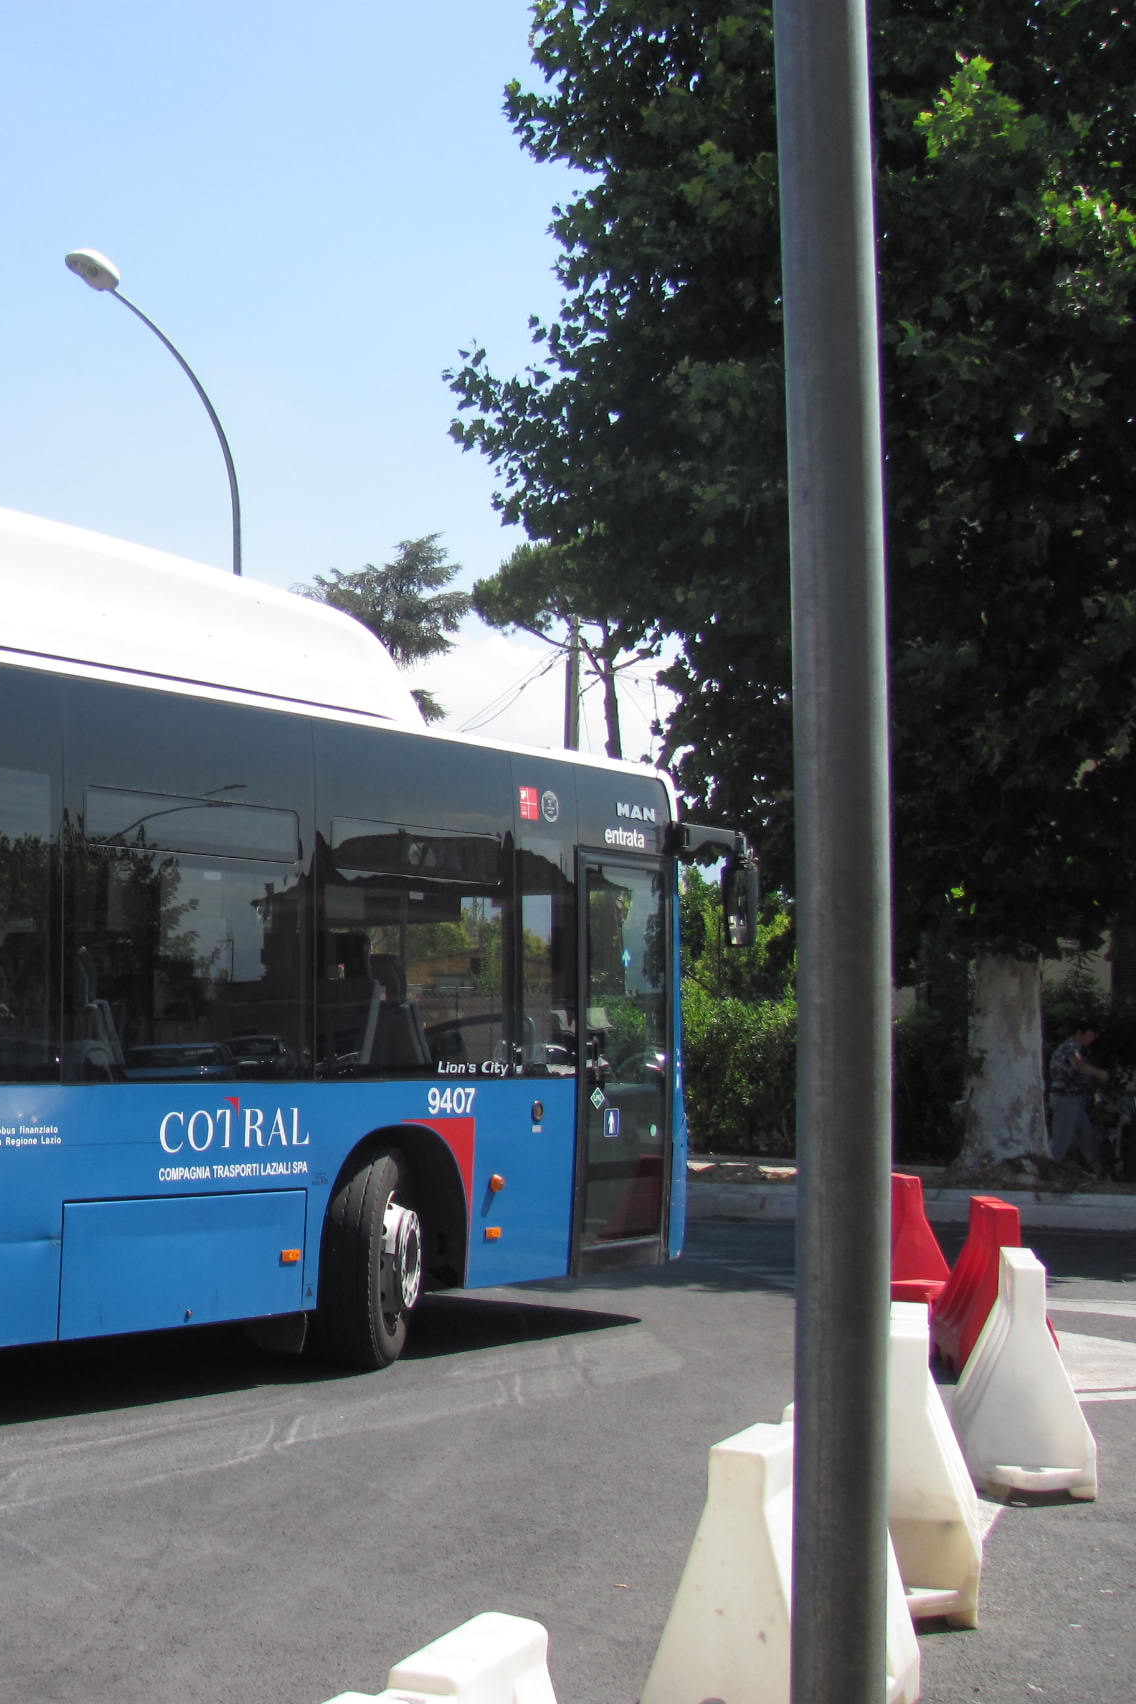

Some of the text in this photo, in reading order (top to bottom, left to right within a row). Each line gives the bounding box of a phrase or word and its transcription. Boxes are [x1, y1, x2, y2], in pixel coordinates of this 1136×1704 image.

[616, 802, 656, 822] MAN
[604, 827, 645, 849] entrata
[437, 1061, 509, 1077] Lion's City
[427, 1087, 476, 1115] 9407
[19, 1125, 59, 1135] finanziato
[159, 1097, 311, 1154] COTRAL
[5, 1137, 38, 1147] Regione
[40, 1135, 62, 1145] Lazio
[158, 1160, 308, 1181] COMPAGNIA TRASPORTI LAZIALI SPA
